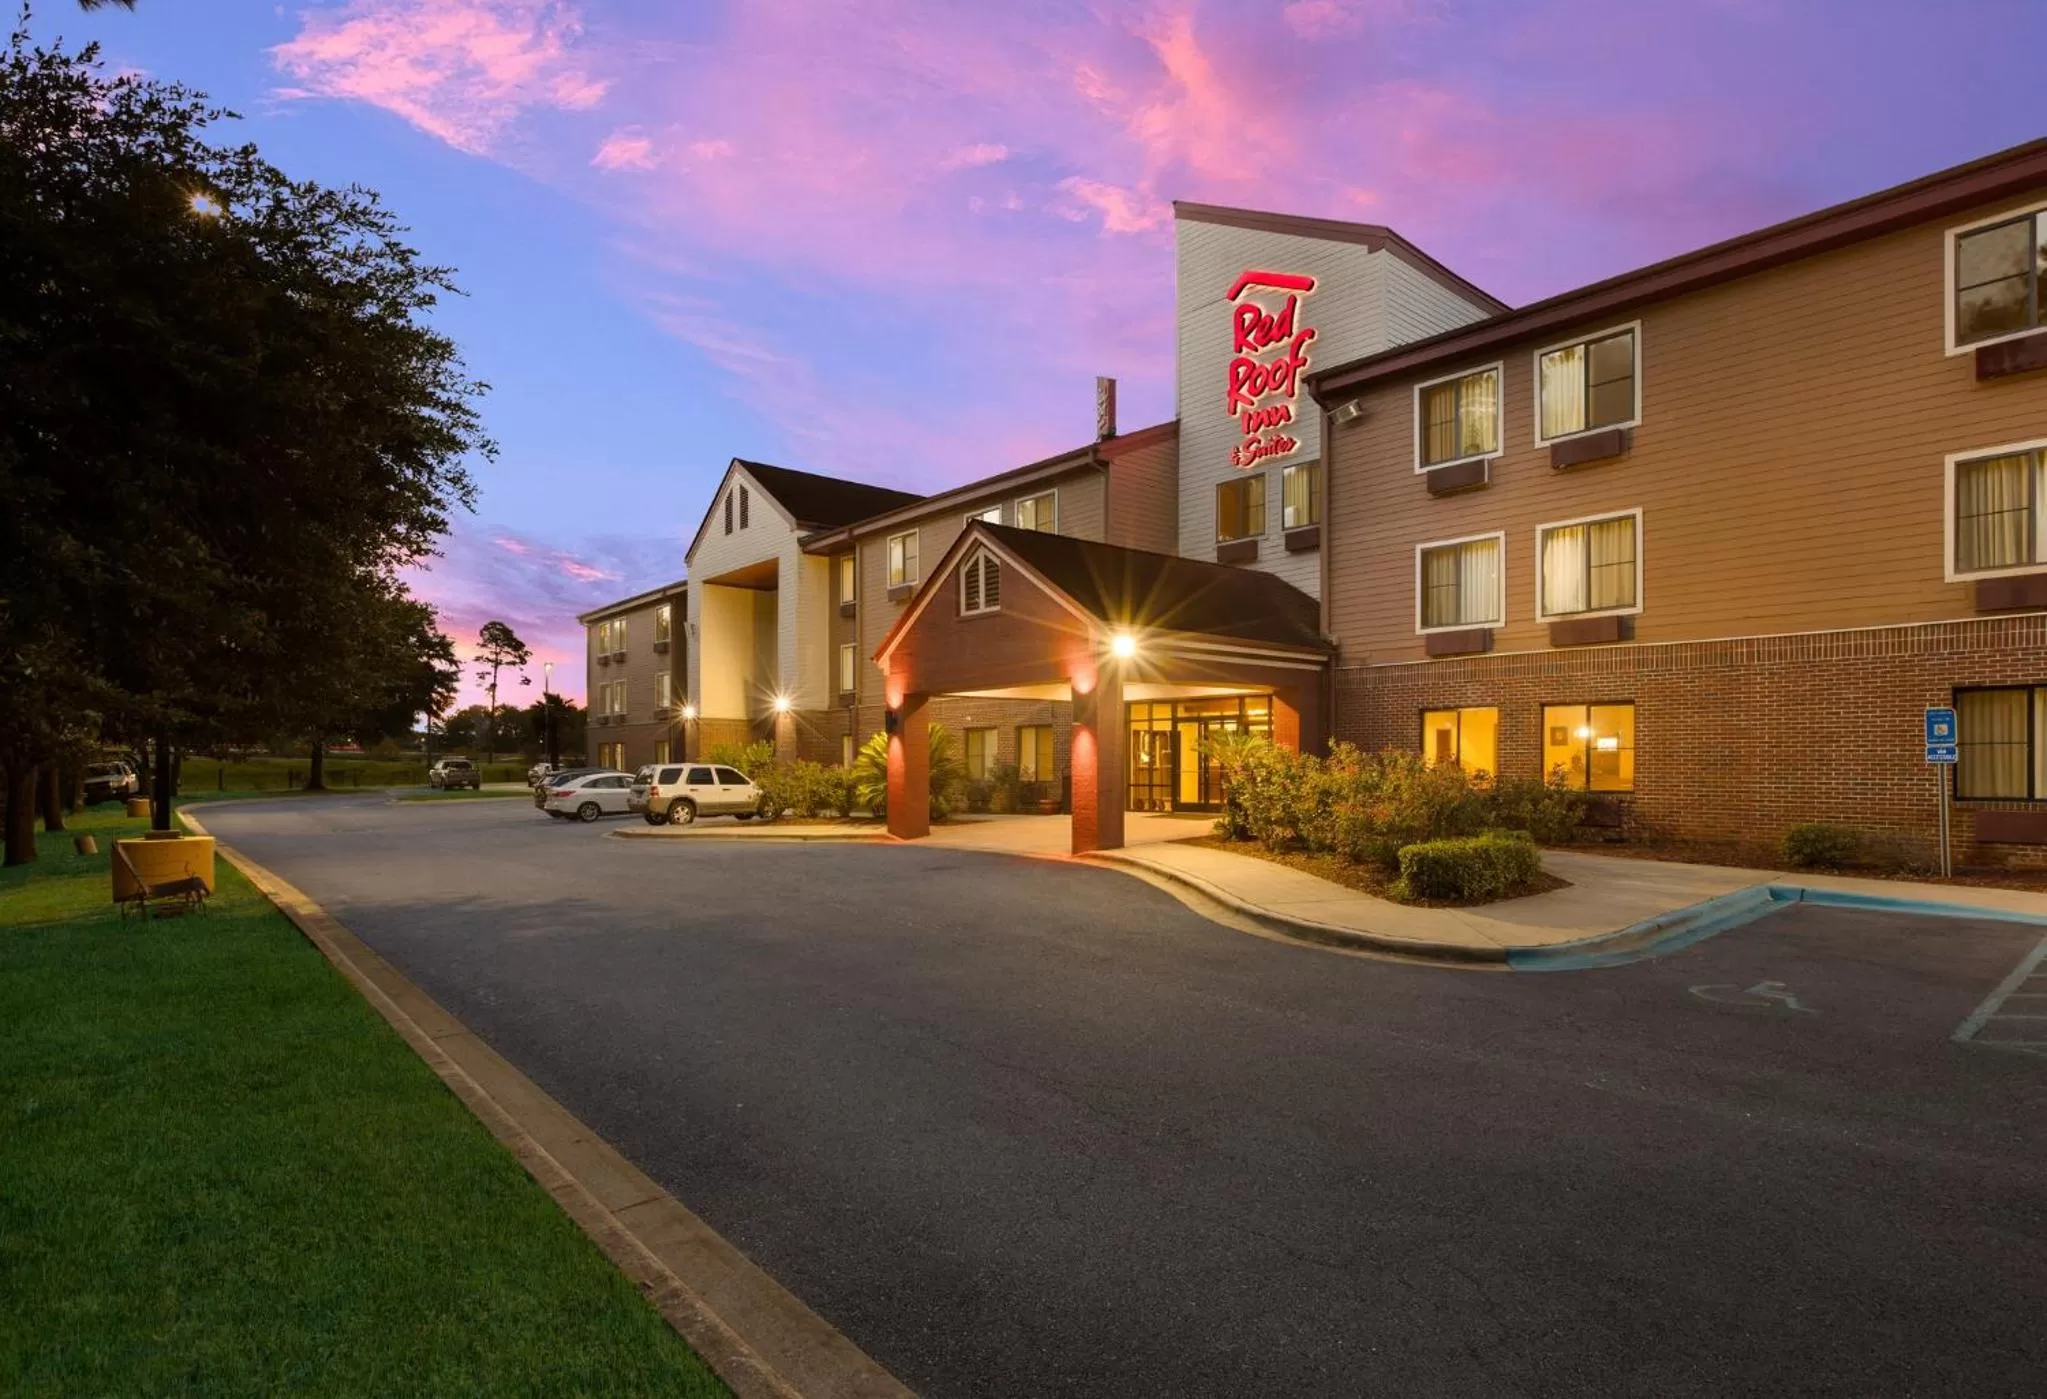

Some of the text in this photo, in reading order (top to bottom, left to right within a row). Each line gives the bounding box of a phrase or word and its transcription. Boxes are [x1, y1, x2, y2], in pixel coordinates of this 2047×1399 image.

[1234, 294, 1297, 353] Red
[1228, 328, 1315, 415] Roof
[1241, 435, 1298, 466] Suites
